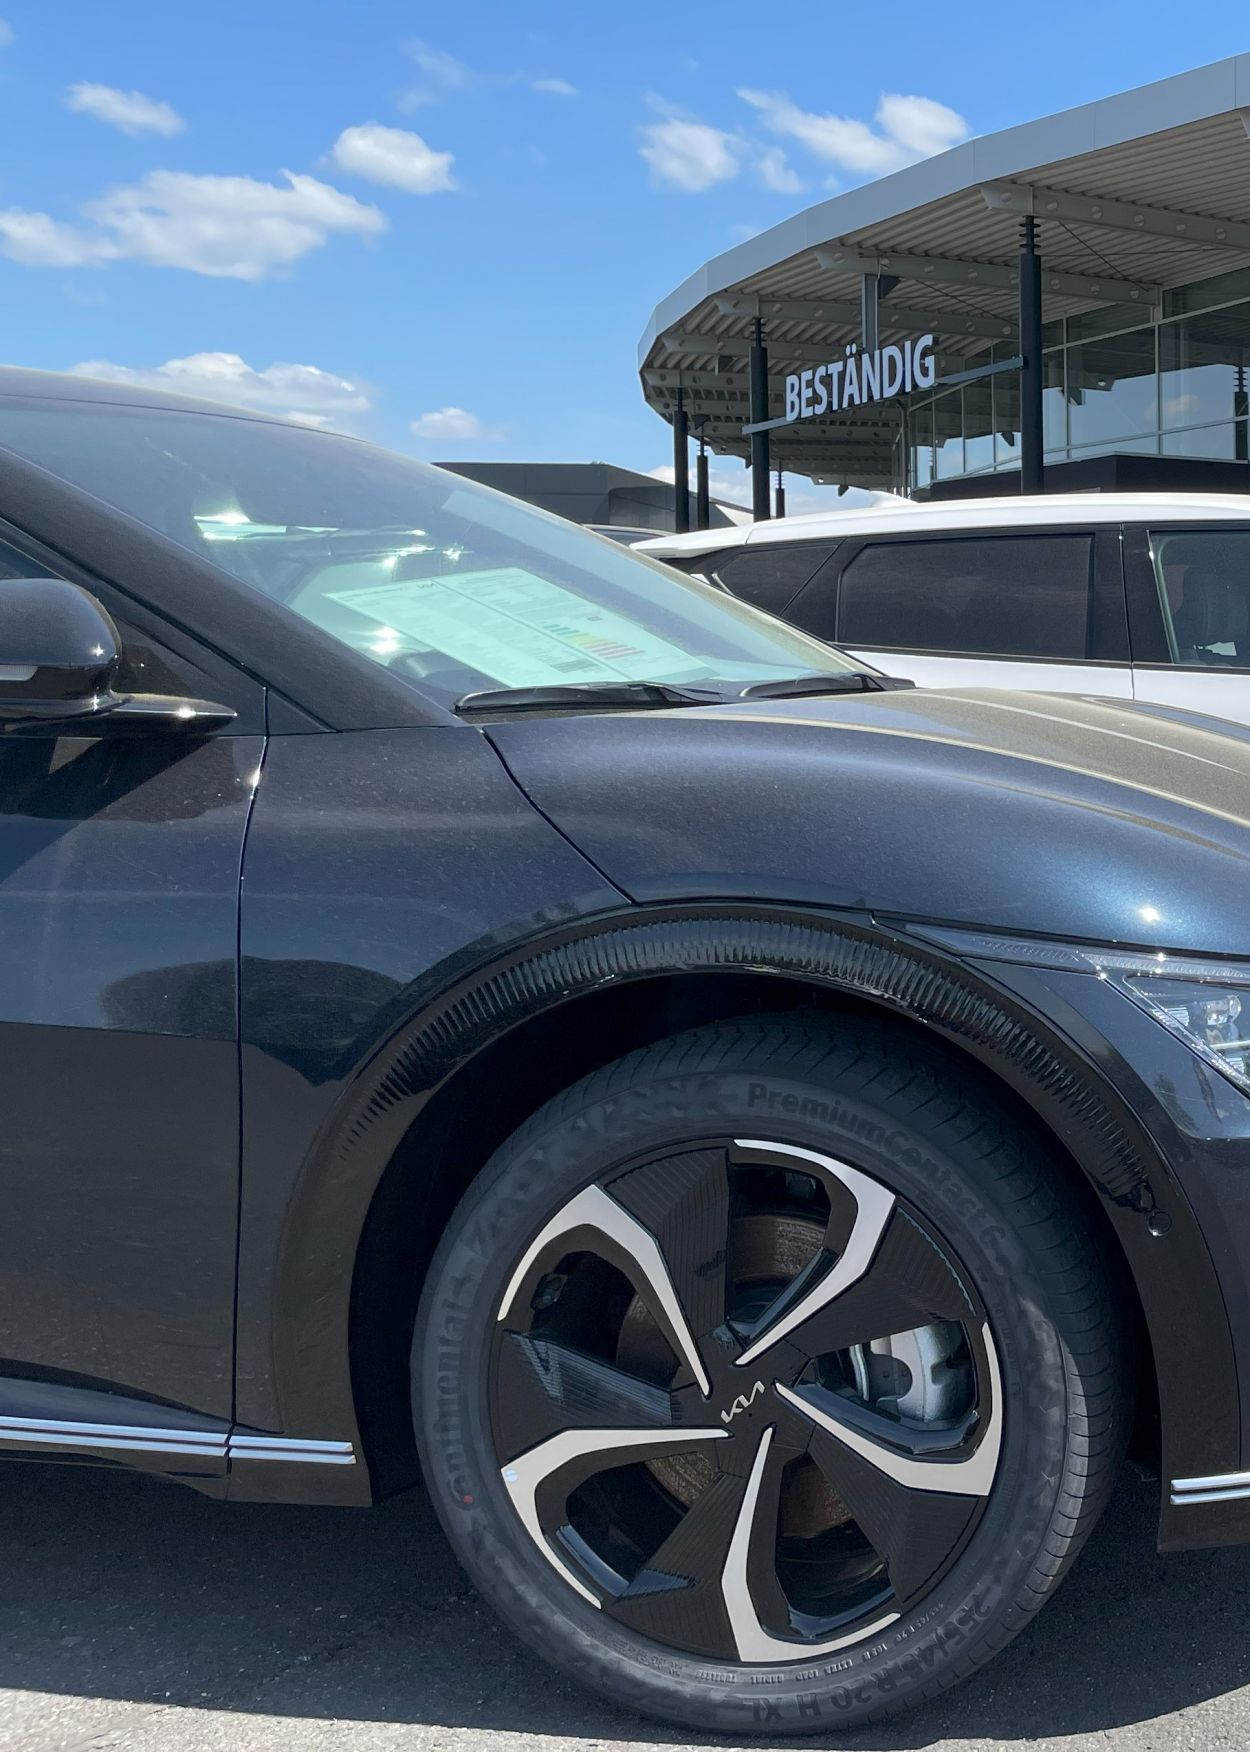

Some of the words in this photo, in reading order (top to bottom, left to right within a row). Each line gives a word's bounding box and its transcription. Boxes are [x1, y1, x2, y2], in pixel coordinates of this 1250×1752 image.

[785, 333, 937, 422] BESTÄNDIG
[747, 1082, 986, 1229] PremiumContact
[720, 1380, 765, 1424] KIA
[873, 1667, 898, 1692] R
[796, 1692, 822, 1718] H
[830, 1685, 873, 1710] 20
